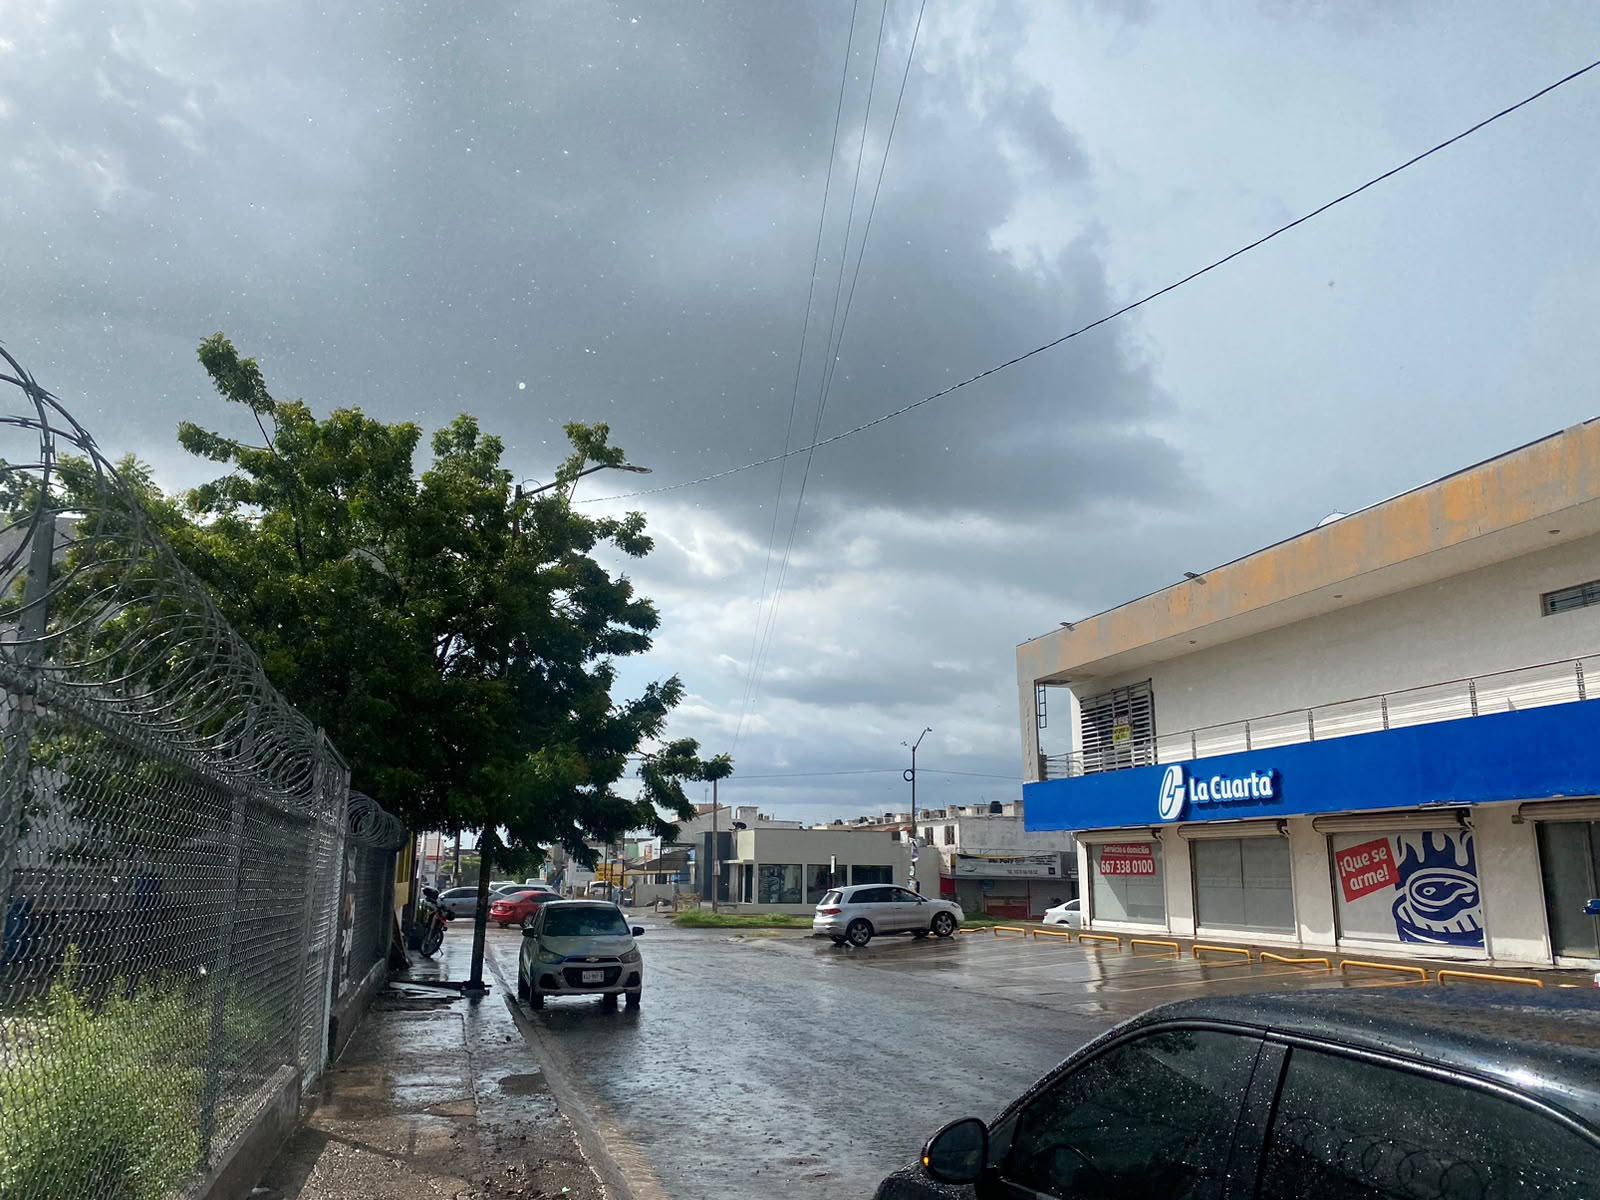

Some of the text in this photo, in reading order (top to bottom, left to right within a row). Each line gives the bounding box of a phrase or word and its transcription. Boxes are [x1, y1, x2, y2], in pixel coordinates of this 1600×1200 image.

[1189, 772, 1273, 801] La Cuarta
[1103, 844, 1122, 853] Servicio
[1127, 845, 1150, 854] domicilio
[1340, 847, 1388, 877] ¡Que se
[1101, 860, 1153, 873] 667 338 0100
[1349, 863, 1390, 891] arme!
